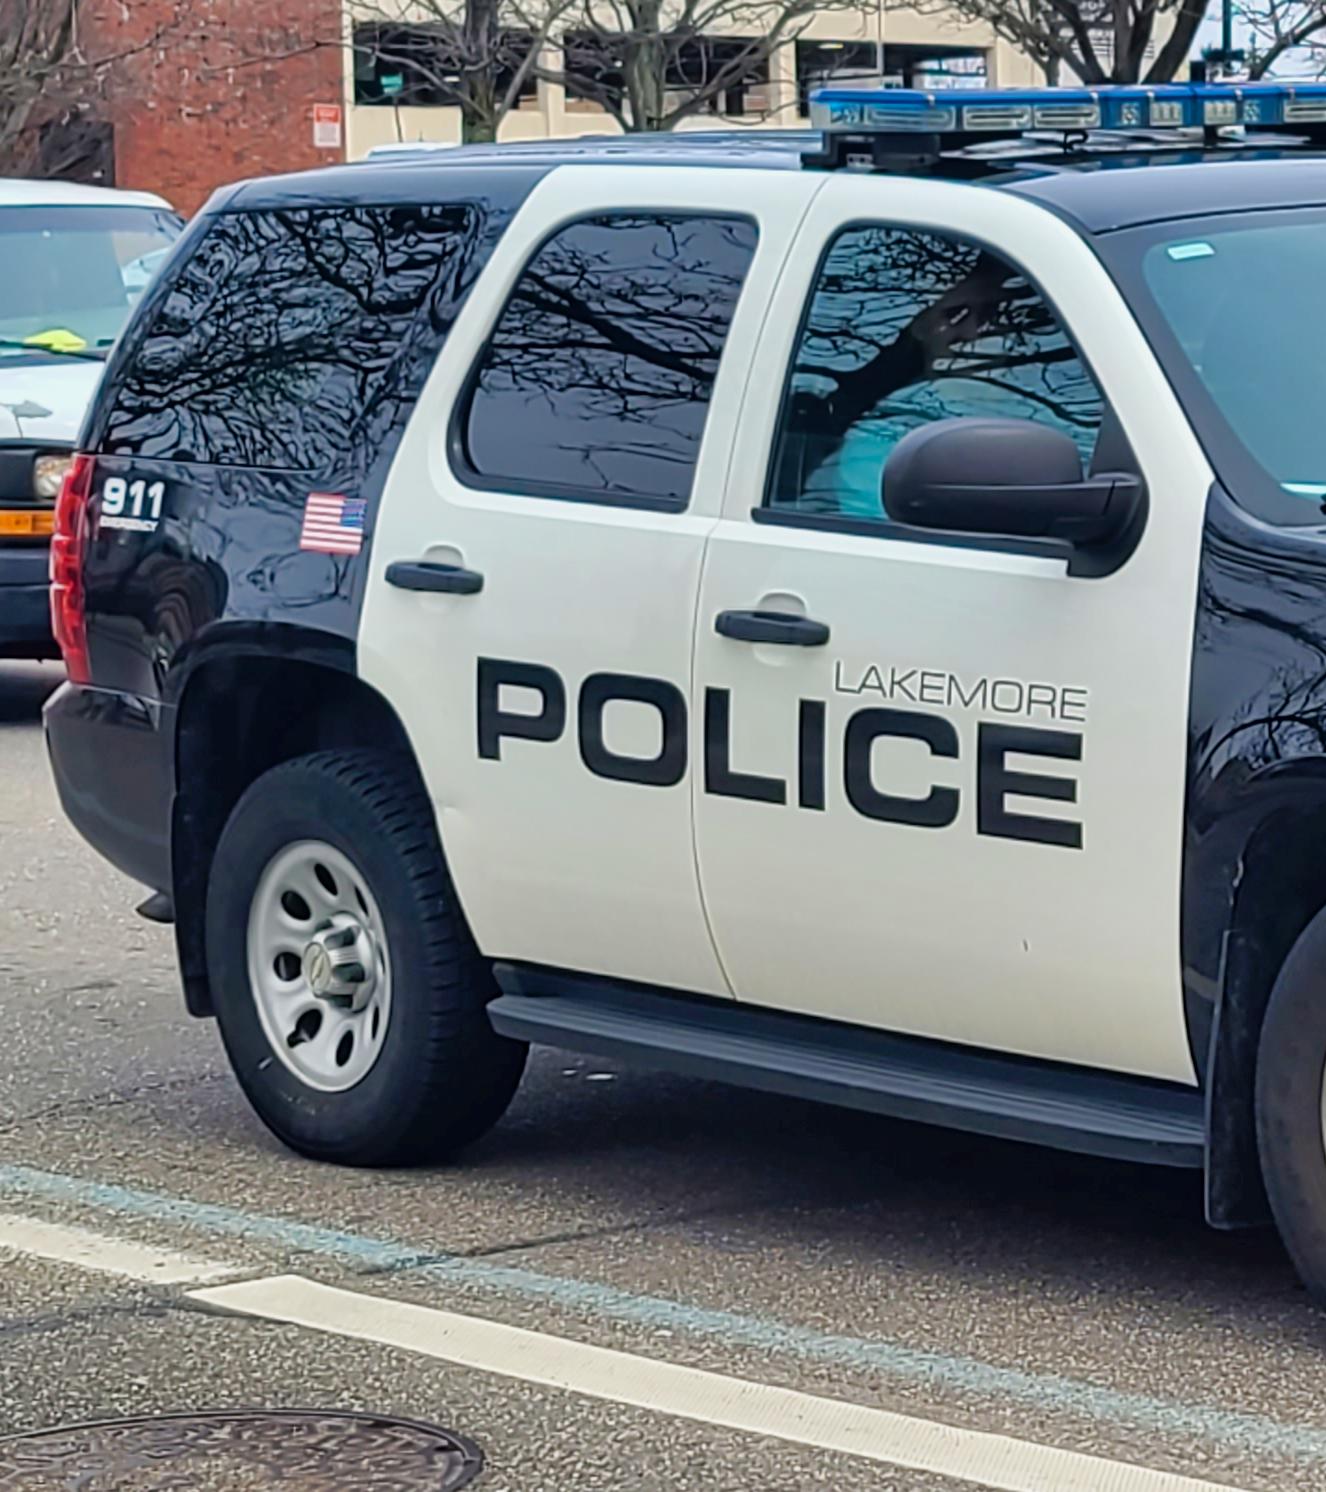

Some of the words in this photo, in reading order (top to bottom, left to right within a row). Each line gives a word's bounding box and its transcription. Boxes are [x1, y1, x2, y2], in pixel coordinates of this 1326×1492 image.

[101, 477, 165, 518] 911
[834, 661, 1088, 722] LAKEMORE
[476, 656, 1084, 850] POLICE
